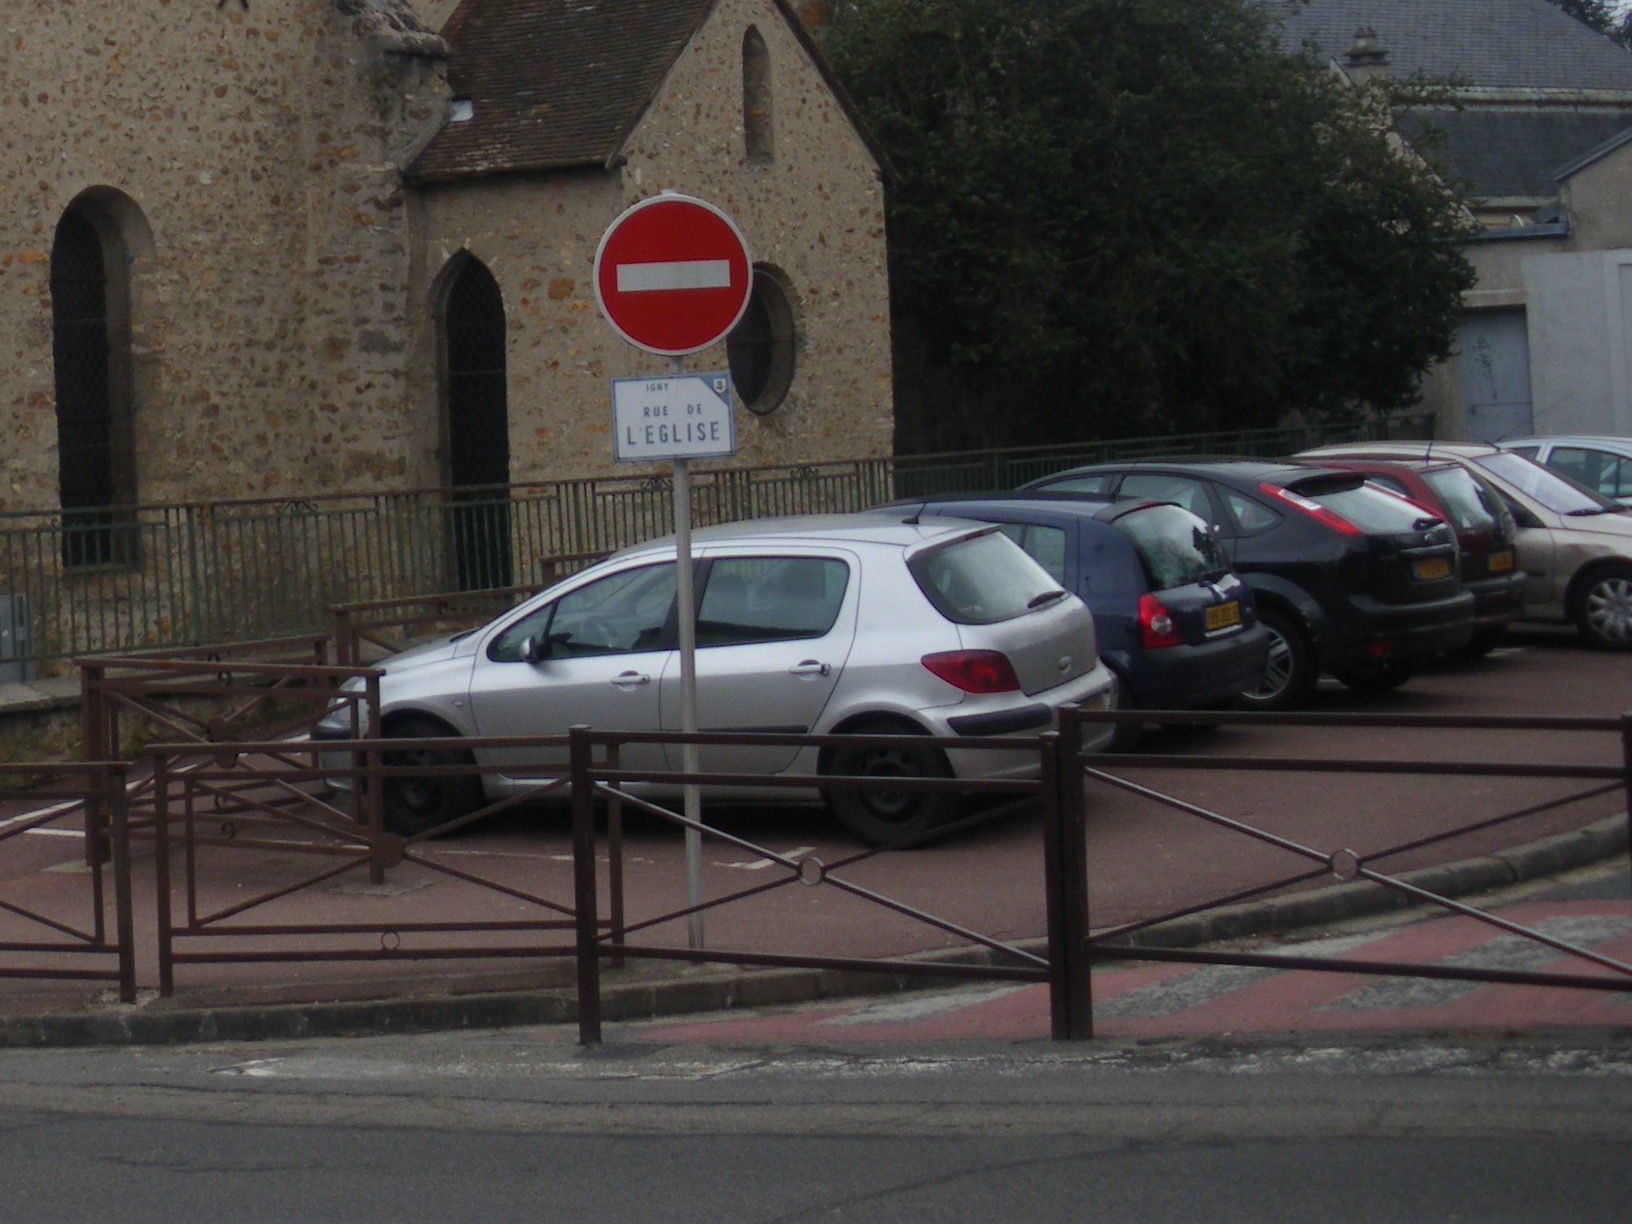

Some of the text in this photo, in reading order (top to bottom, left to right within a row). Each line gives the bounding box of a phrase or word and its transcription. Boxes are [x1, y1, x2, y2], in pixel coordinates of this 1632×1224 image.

[646, 382, 670, 392] IGNY
[643, 403, 702, 417] RUE DE
[626, 421, 720, 445] L'EGLISE
